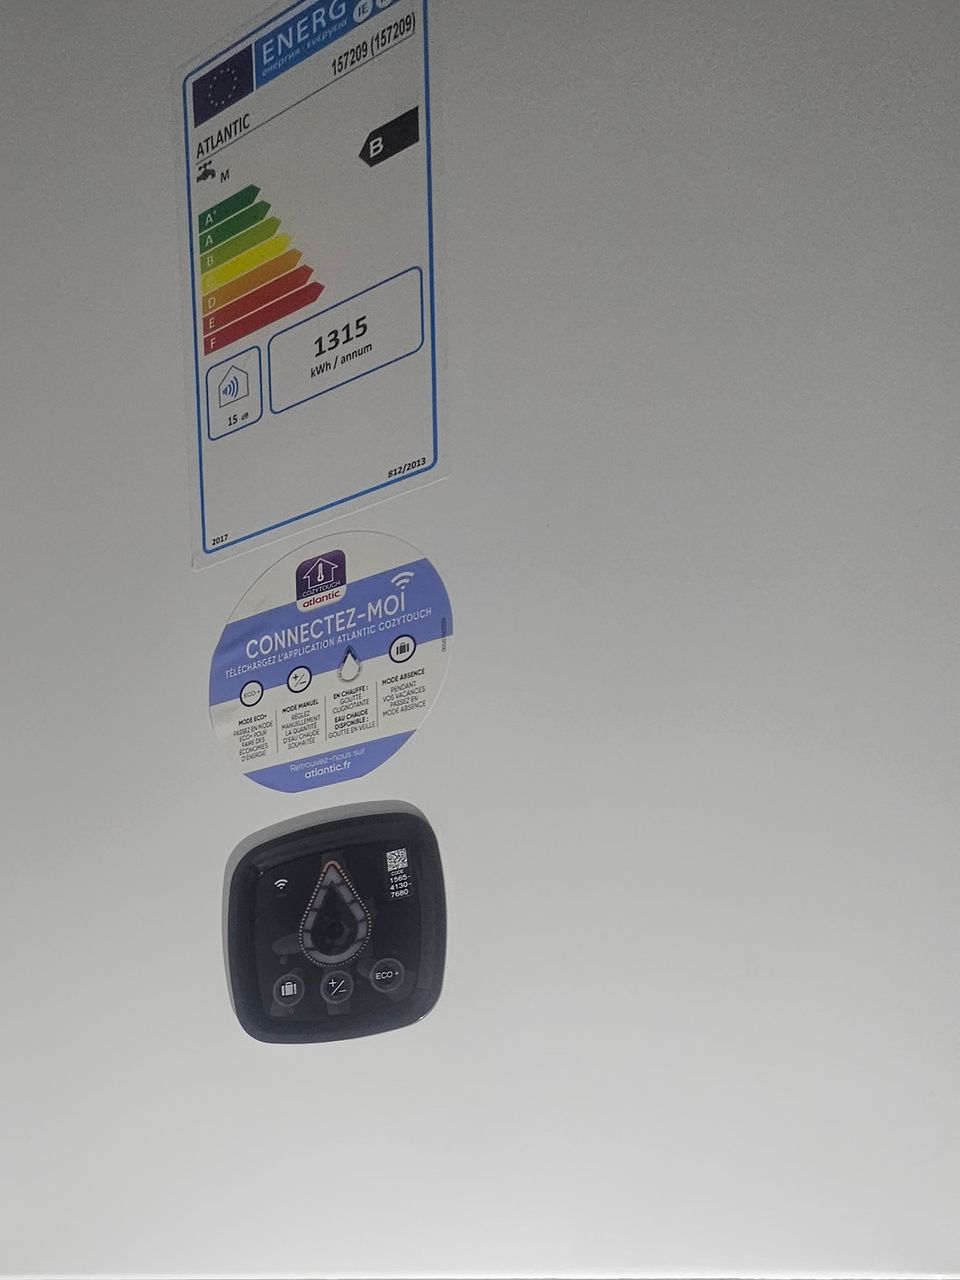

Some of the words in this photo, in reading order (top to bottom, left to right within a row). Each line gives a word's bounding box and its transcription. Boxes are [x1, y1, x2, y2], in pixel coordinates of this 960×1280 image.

[262, 0, 346, 65] ENERG
[331, 41, 368, 76] 157209
[371, 12, 416, 56] (157209)
[196, 113, 250, 159] ATLANTIC
[369, 137, 384, 158] B
[220, 169, 230, 183] M
[205, 235, 214, 247] A
[207, 255, 214, 267] B
[209, 317, 215, 329] E
[210, 337, 216, 349] F
[314, 315, 368, 358] 1315
[310, 360, 332, 379] kWh
[340, 341, 373, 365] annum
[227, 414, 238, 427] 15
[387, 457, 426, 478] 812/2013
[212, 533, 228, 546] 2017
[302, 589, 341, 608] atlantic
[246, 591, 405, 659] CONNECTEZ-MOI
[278, 638, 335, 662] L'APPLICATION
[337, 624, 376, 643] ATLANTIC
[379, 607, 432, 632] COZYTOUCH
[381, 675, 398, 686] MODE
[400, 668, 425, 680] ABSENCE
[305, 760, 351, 779] atlantic.fr
[390, 889, 409, 898] 7680
[375, 971, 393, 980] ECO
